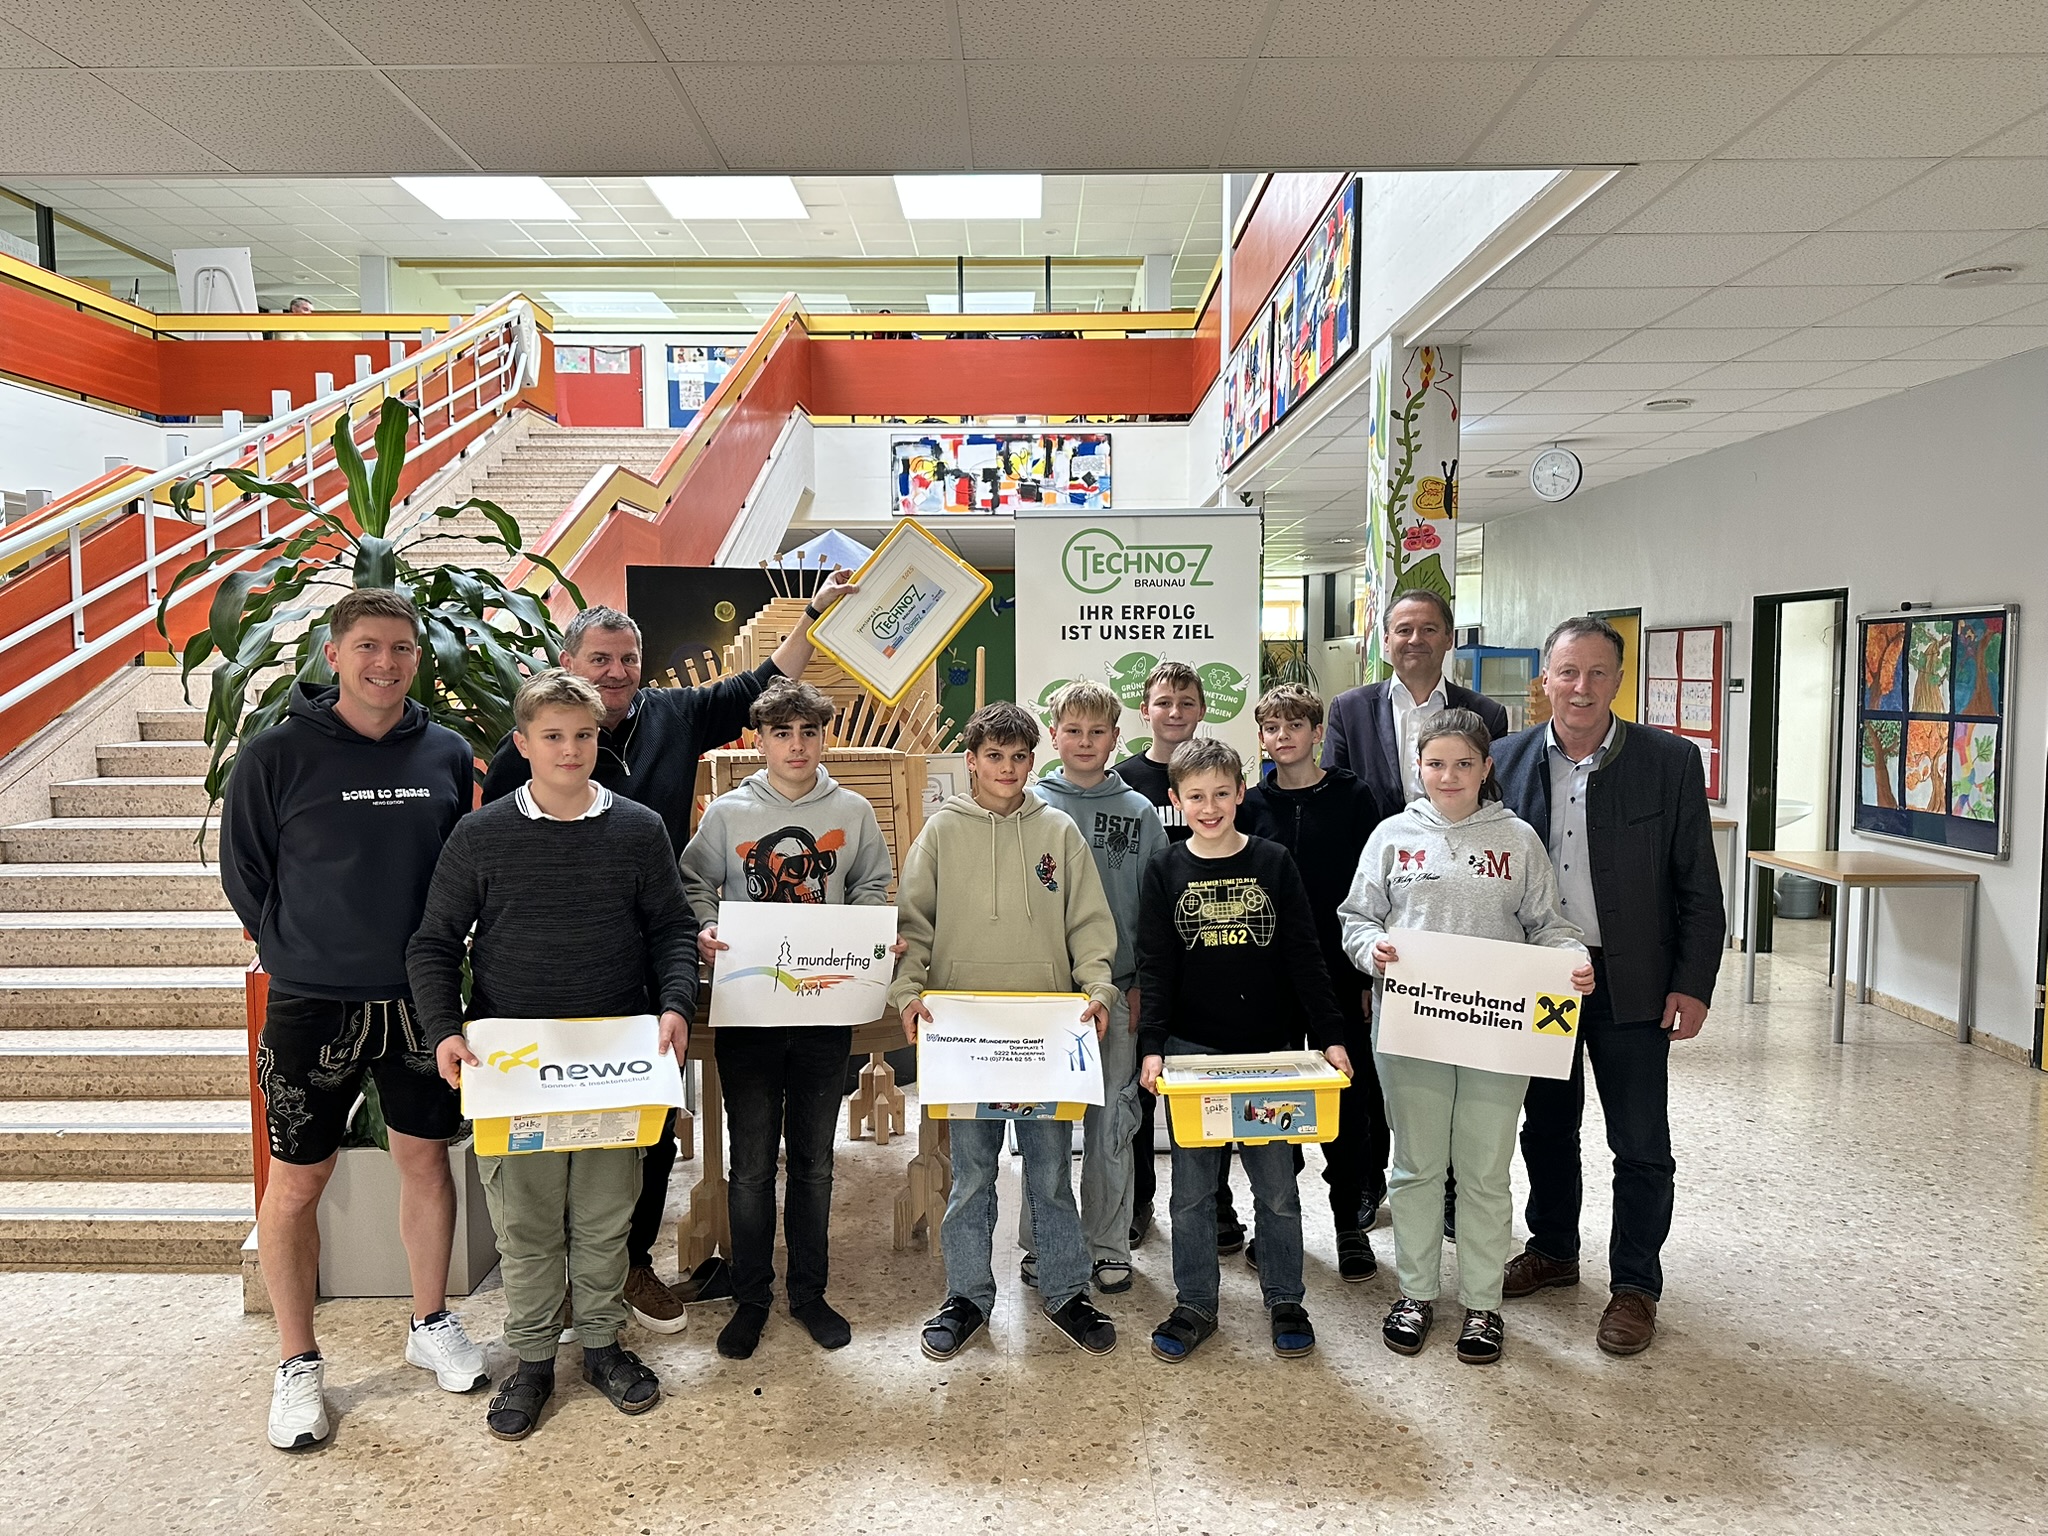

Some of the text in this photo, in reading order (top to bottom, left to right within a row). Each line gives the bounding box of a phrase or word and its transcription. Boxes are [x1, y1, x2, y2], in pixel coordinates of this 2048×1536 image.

[1074, 544, 1214, 586] TECHNO-Z
[1134, 579, 1186, 588] BRAUNAU
[874, 584, 926, 636] TECHNO-Z
[1079, 604, 1196, 620] IHR ERFOLG
[1061, 624, 1214, 640] IST UNSER ZIEL
[1121, 682, 1145, 691] GRÜND
[1121, 690, 1144, 699] BERAT
[1206, 707, 1232, 718] ERGIEN
[1484, 850, 1512, 880] M
[1229, 930, 1247, 945] 62
[797, 948, 870, 970] munderfing
[1385, 977, 1526, 1013] Real-Treuhand
[1413, 1001, 1523, 1031] Immobilien
[926, 1033, 977, 1044] WINDPARK
[540, 1061, 652, 1081] newo
[588, 1076, 651, 1086] Insektenschutz
